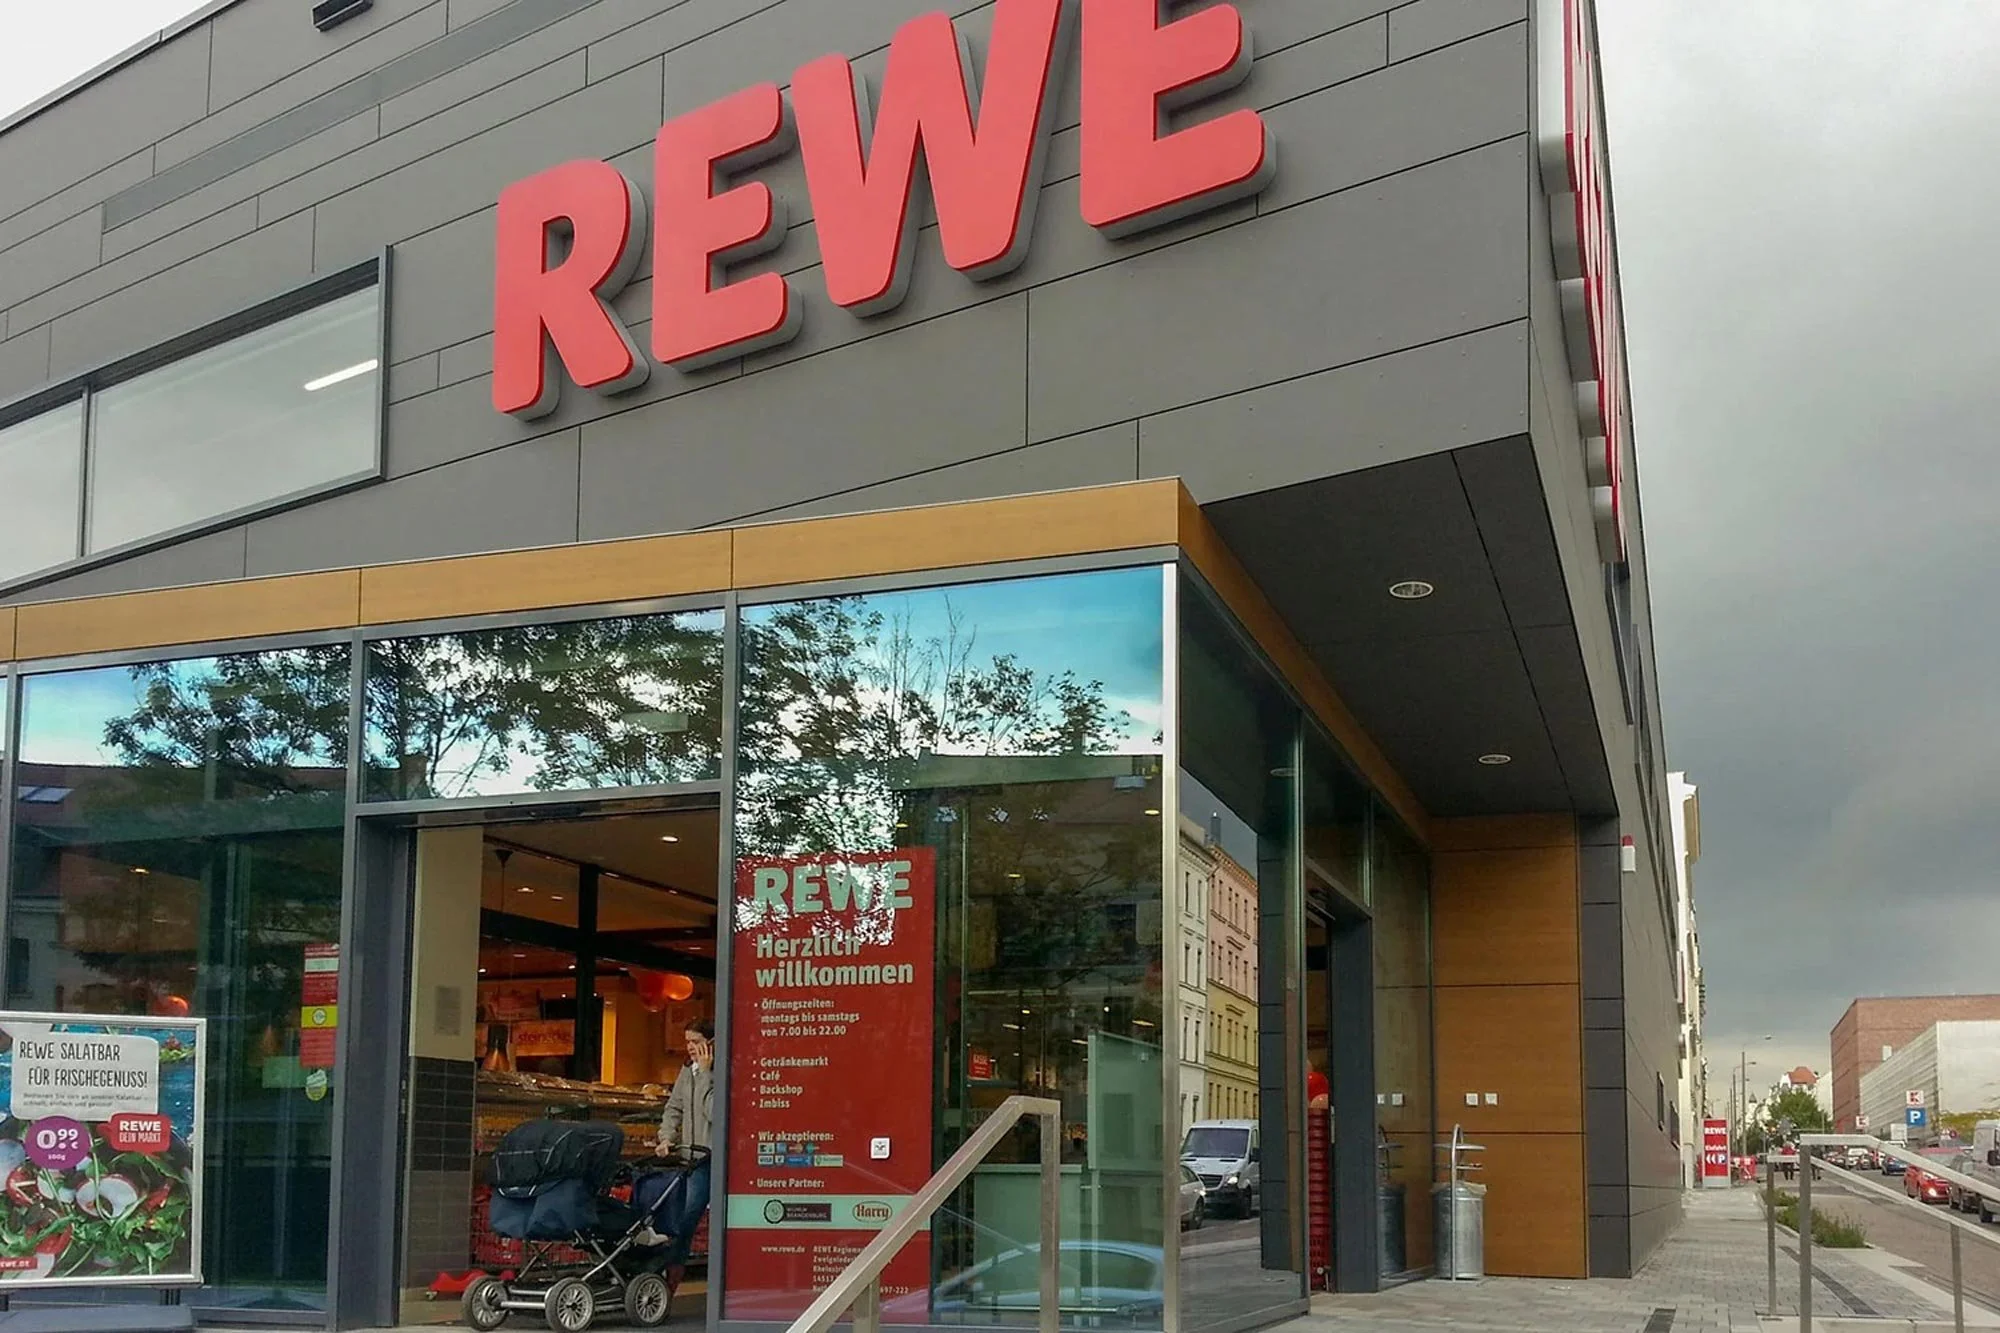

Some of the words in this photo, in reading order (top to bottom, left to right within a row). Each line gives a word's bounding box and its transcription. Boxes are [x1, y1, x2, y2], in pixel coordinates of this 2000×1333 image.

[491, 0, 1272, 418] REWE
[755, 861, 914, 915] REWE
[756, 930, 861, 958] Herzlich
[756, 961, 914, 987] willkommen
[761, 998, 835, 1011] Öffnungszeiten:
[761, 1014, 799, 1024] montags
[801, 1013, 816, 1022] bis
[818, 1012, 860, 1023] samstags
[761, 1028, 778, 1037] von
[780, 1027, 801, 1036] 7.00
[803, 1026, 816, 1035] bis
[819, 1025, 847, 1035] 22.00
[20, 1041, 55, 1060] REWE
[61, 1042, 121, 1061] SALATBAR
[760, 1056, 829, 1067] Getränkemarkt
[28, 1066, 50, 1086] FÜR
[55, 1068, 149, 1089] FRISCHEGENUSS!
[760, 1070, 781, 1080] Café
[760, 1085, 803, 1096] Backshop
[760, 1098, 790, 1108] Imbiss
[1909, 1110, 1921, 1123] P
[119, 1121, 161, 1131] REWE
[758, 1131, 773, 1141] Wir
[776, 1131, 834, 1142] akzeptieren:
[757, 1178, 787, 1188] Unsere
[789, 1178, 825, 1188] Partner:
[856, 1203, 889, 1219] Harry
